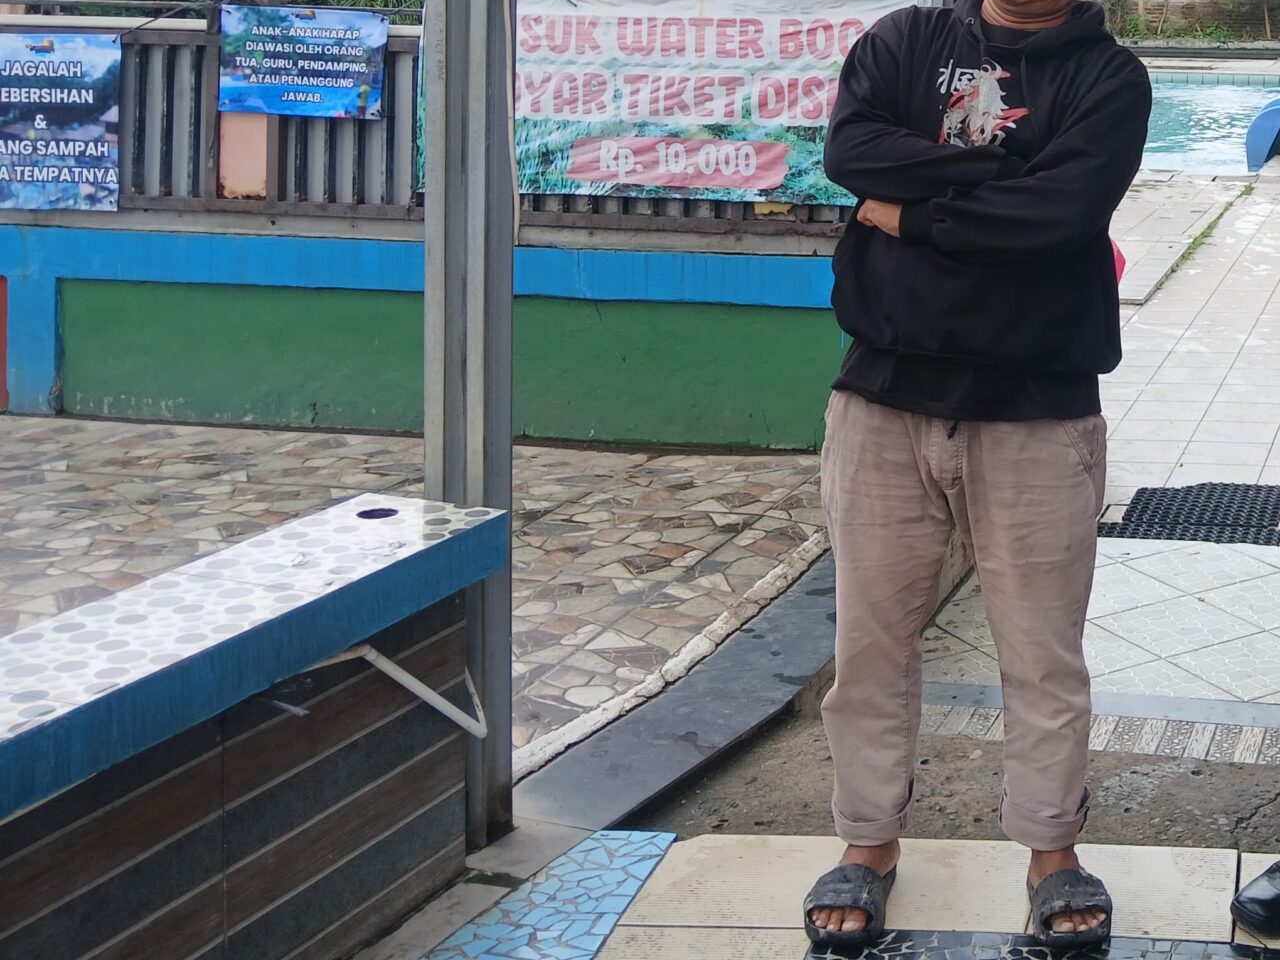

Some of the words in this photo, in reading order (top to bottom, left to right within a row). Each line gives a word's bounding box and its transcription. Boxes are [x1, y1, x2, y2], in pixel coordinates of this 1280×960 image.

[251, 25, 320, 39] ANAK-ANAK
[321, 29, 360, 41] HARAP
[616, 16, 765, 59] WATER
[245, 41, 293, 53] DIAWASI
[295, 43, 322, 55] OLEH
[324, 45, 364, 57] ORANG
[1, 61, 82, 77] JAGALAH
[235, 56, 260, 68] TUA,
[262, 58, 296, 70] GURU,
[297, 60, 369, 74] PENDAMPING,
[249, 73, 279, 85] ATAU
[281, 75, 354, 88] PENANGGUNG
[281, 91, 324, 103] JAWAB.
[623, 73, 745, 118] TIKET
[33, 114, 48, 129] &
[36, 141, 109, 157] SAMPAH
[600, 140, 645, 181] Rp.
[656, 141, 757, 177] 10.000
[14, 166, 118, 184] TEMPATNYA
